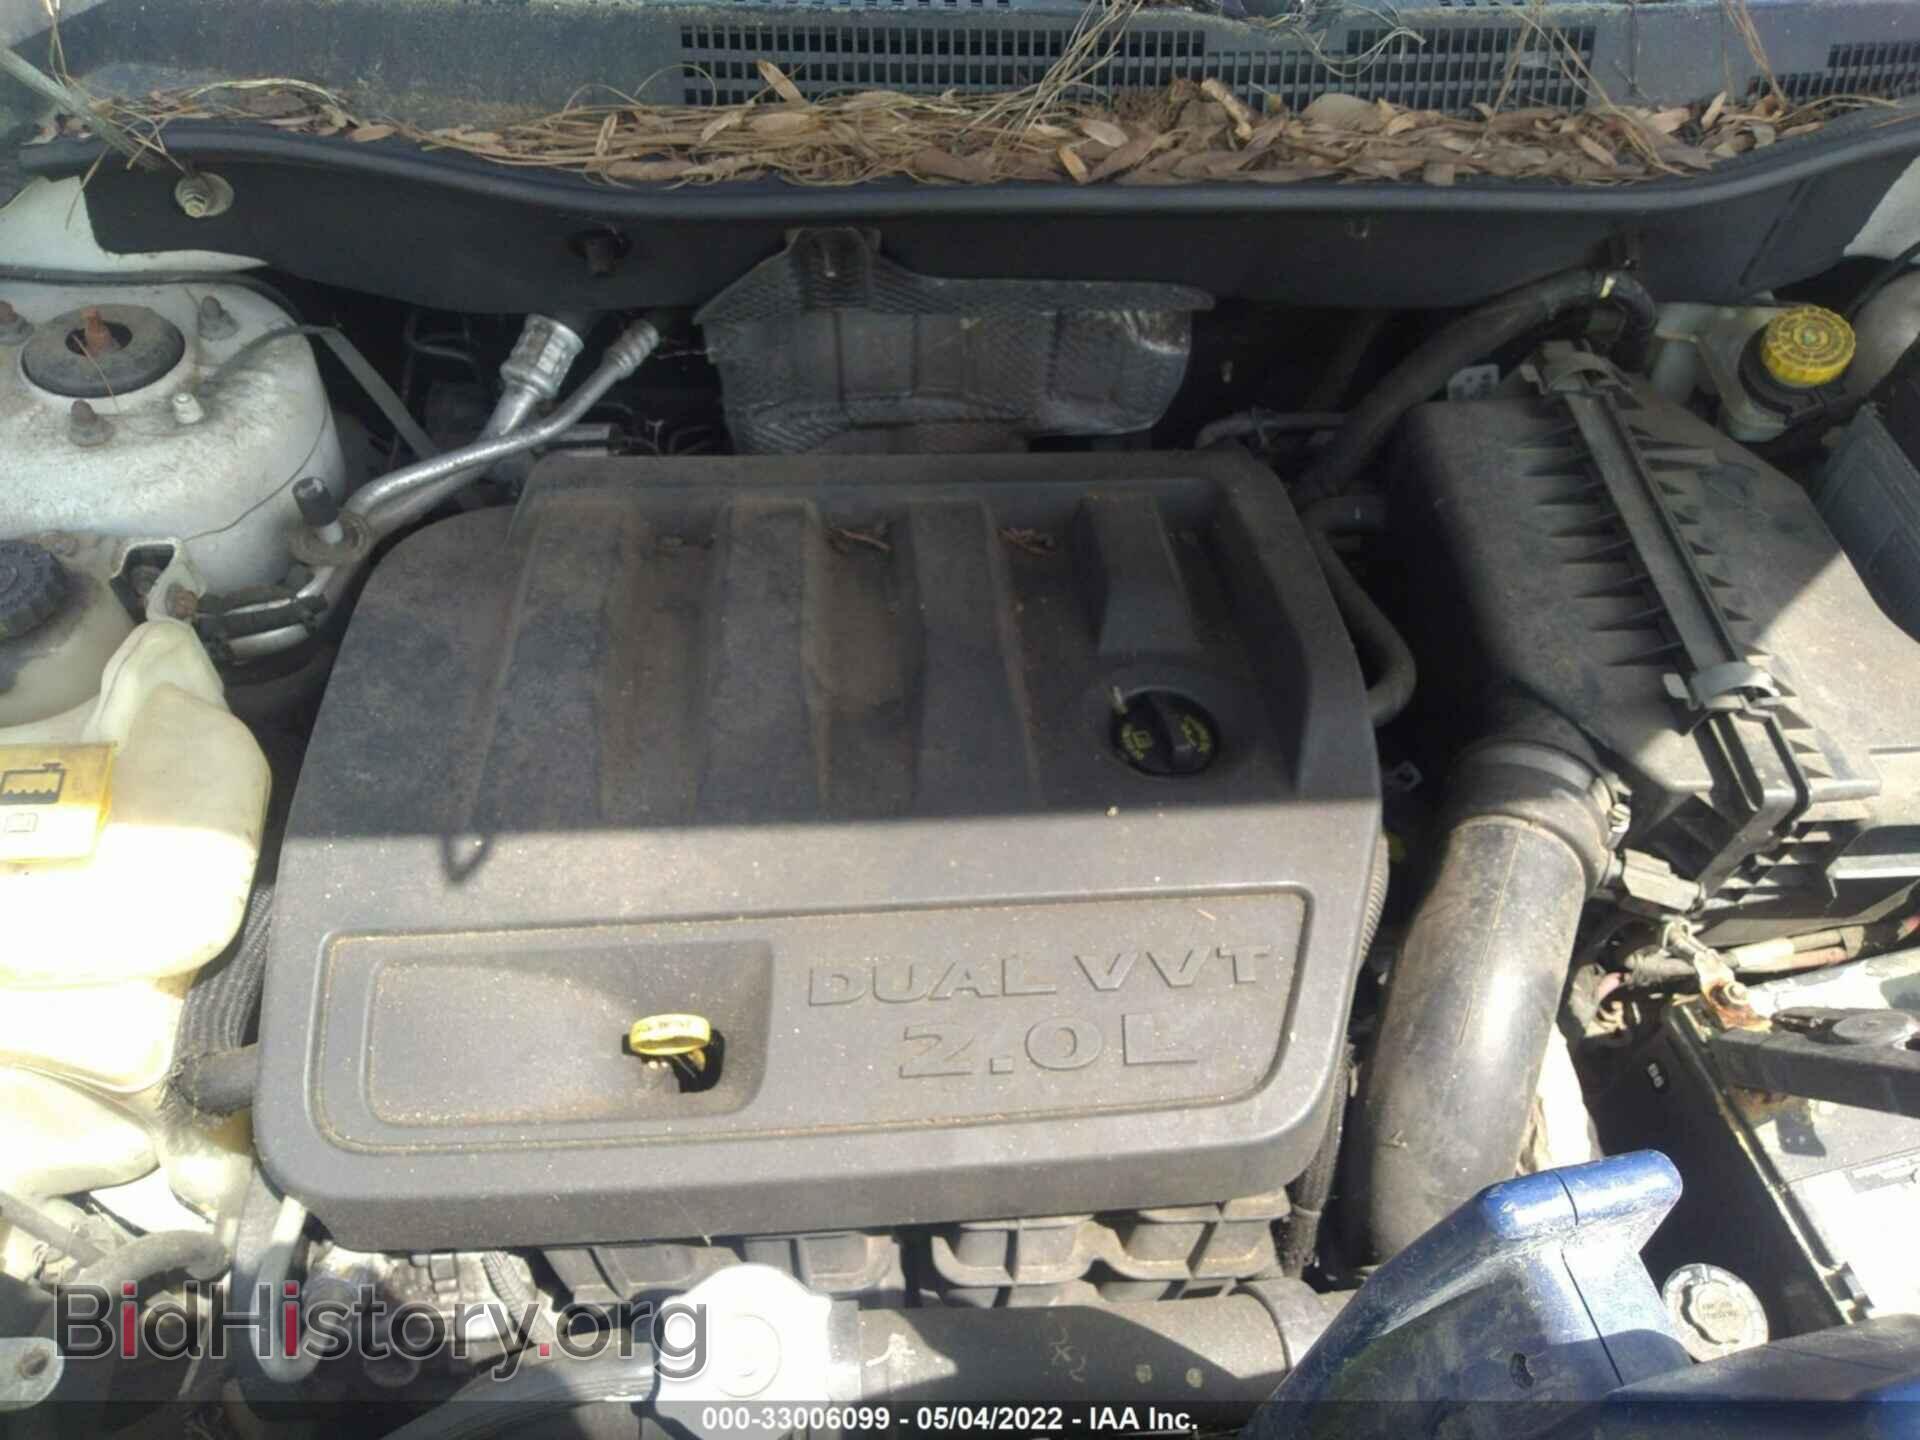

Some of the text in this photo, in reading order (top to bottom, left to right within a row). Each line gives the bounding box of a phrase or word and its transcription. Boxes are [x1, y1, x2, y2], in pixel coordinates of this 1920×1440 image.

[808, 944, 1271, 1006] DUAL VVT
[899, 1012, 1199, 1078] 2.0L
